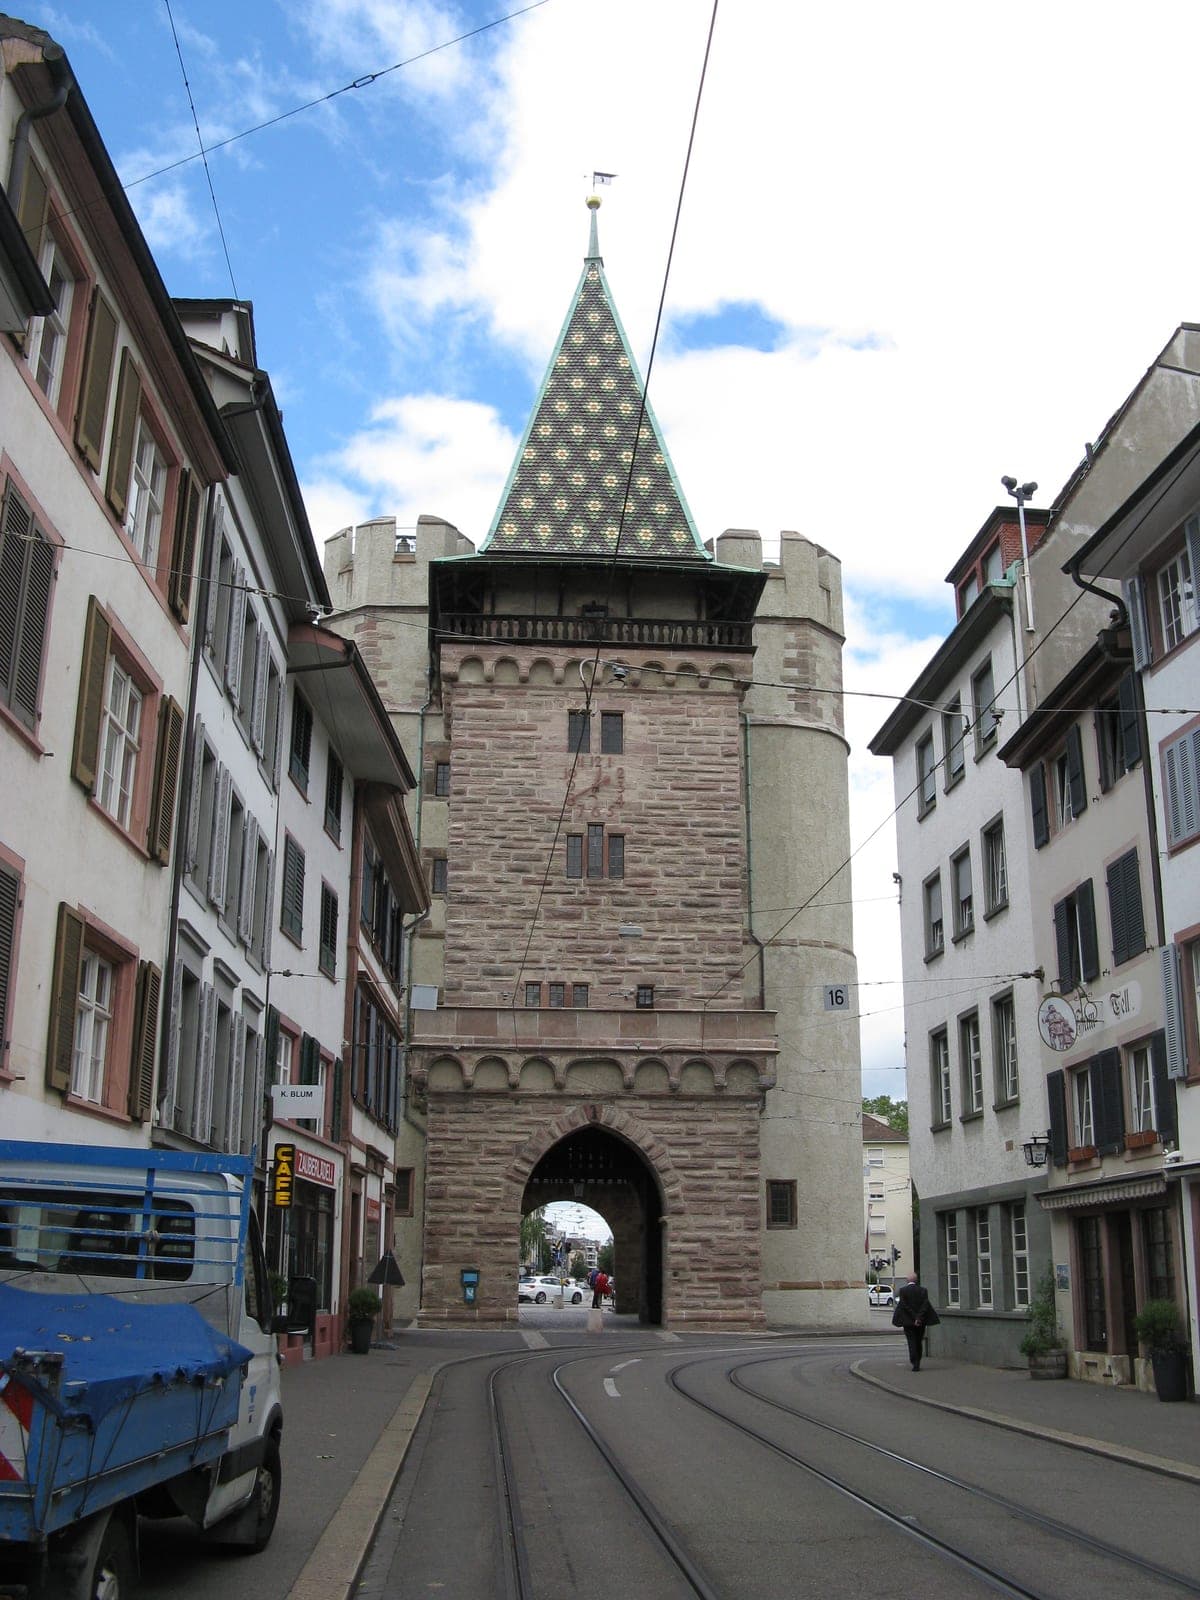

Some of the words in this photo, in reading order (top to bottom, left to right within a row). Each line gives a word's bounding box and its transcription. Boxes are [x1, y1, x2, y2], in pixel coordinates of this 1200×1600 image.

[616, 768, 625, 779] 2
[615, 794, 625, 808] 4
[829, 989, 844, 1006] 16
[280, 1090, 288, 1098] K.
[290, 1090, 313, 1098] BLUM
[276, 1147, 292, 1206] CAFE
